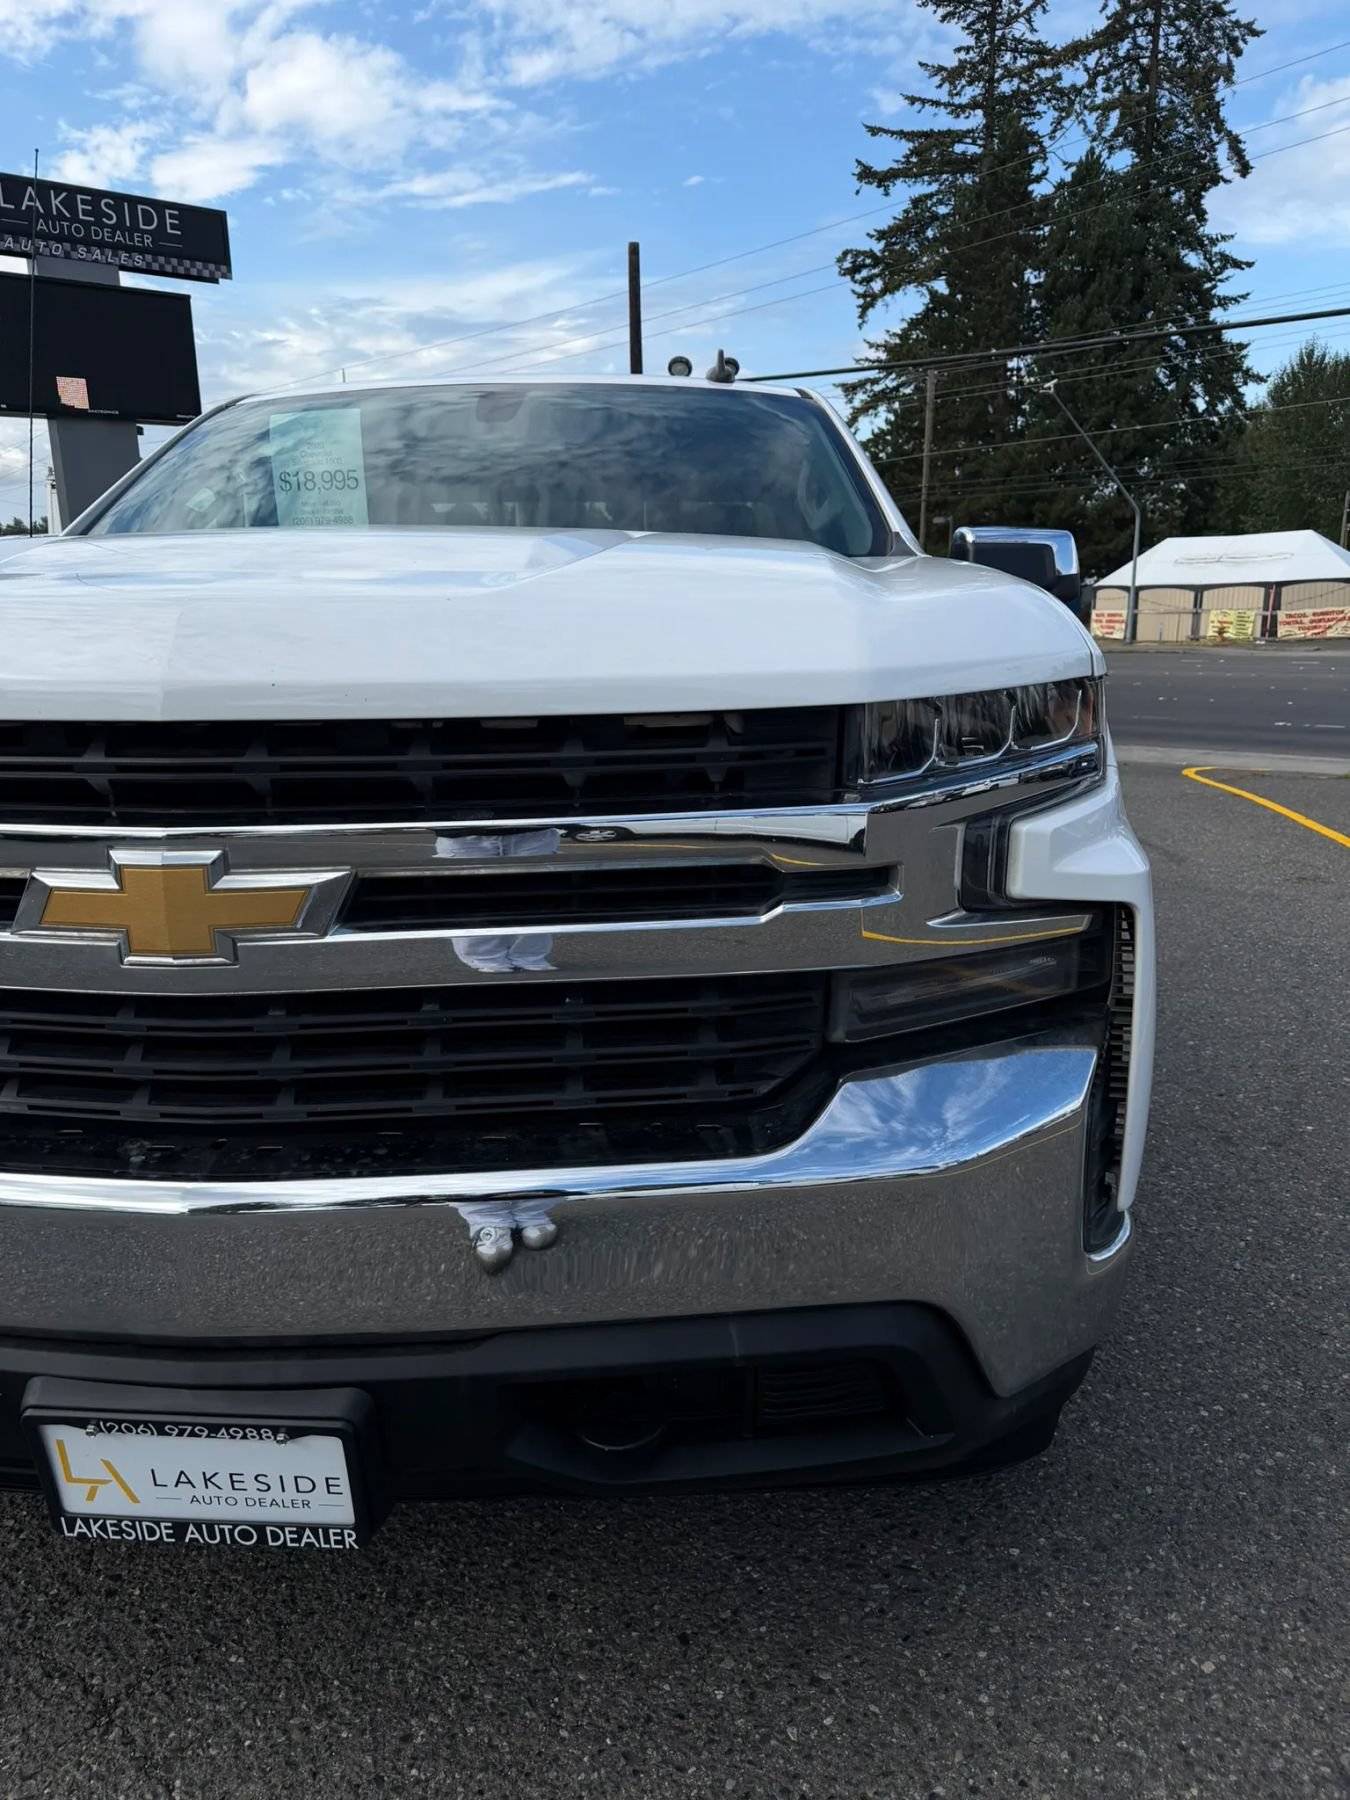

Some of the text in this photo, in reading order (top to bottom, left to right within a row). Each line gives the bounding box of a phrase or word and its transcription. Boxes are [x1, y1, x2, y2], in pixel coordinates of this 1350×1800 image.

[0, 181, 182, 235] LAKESIDE
[36, 218, 153, 248] AUTO DEALER
[4, 236, 143, 267] AUTO SALES
[279, 468, 359, 495] $18,995
[100, 1421, 275, 1441] (206) 979-4988
[151, 1468, 343, 1495] LAKESIDE
[190, 1494, 311, 1509] AUTO DEALER
[61, 1516, 359, 1549] LAKESIDE AUTO DEALER
